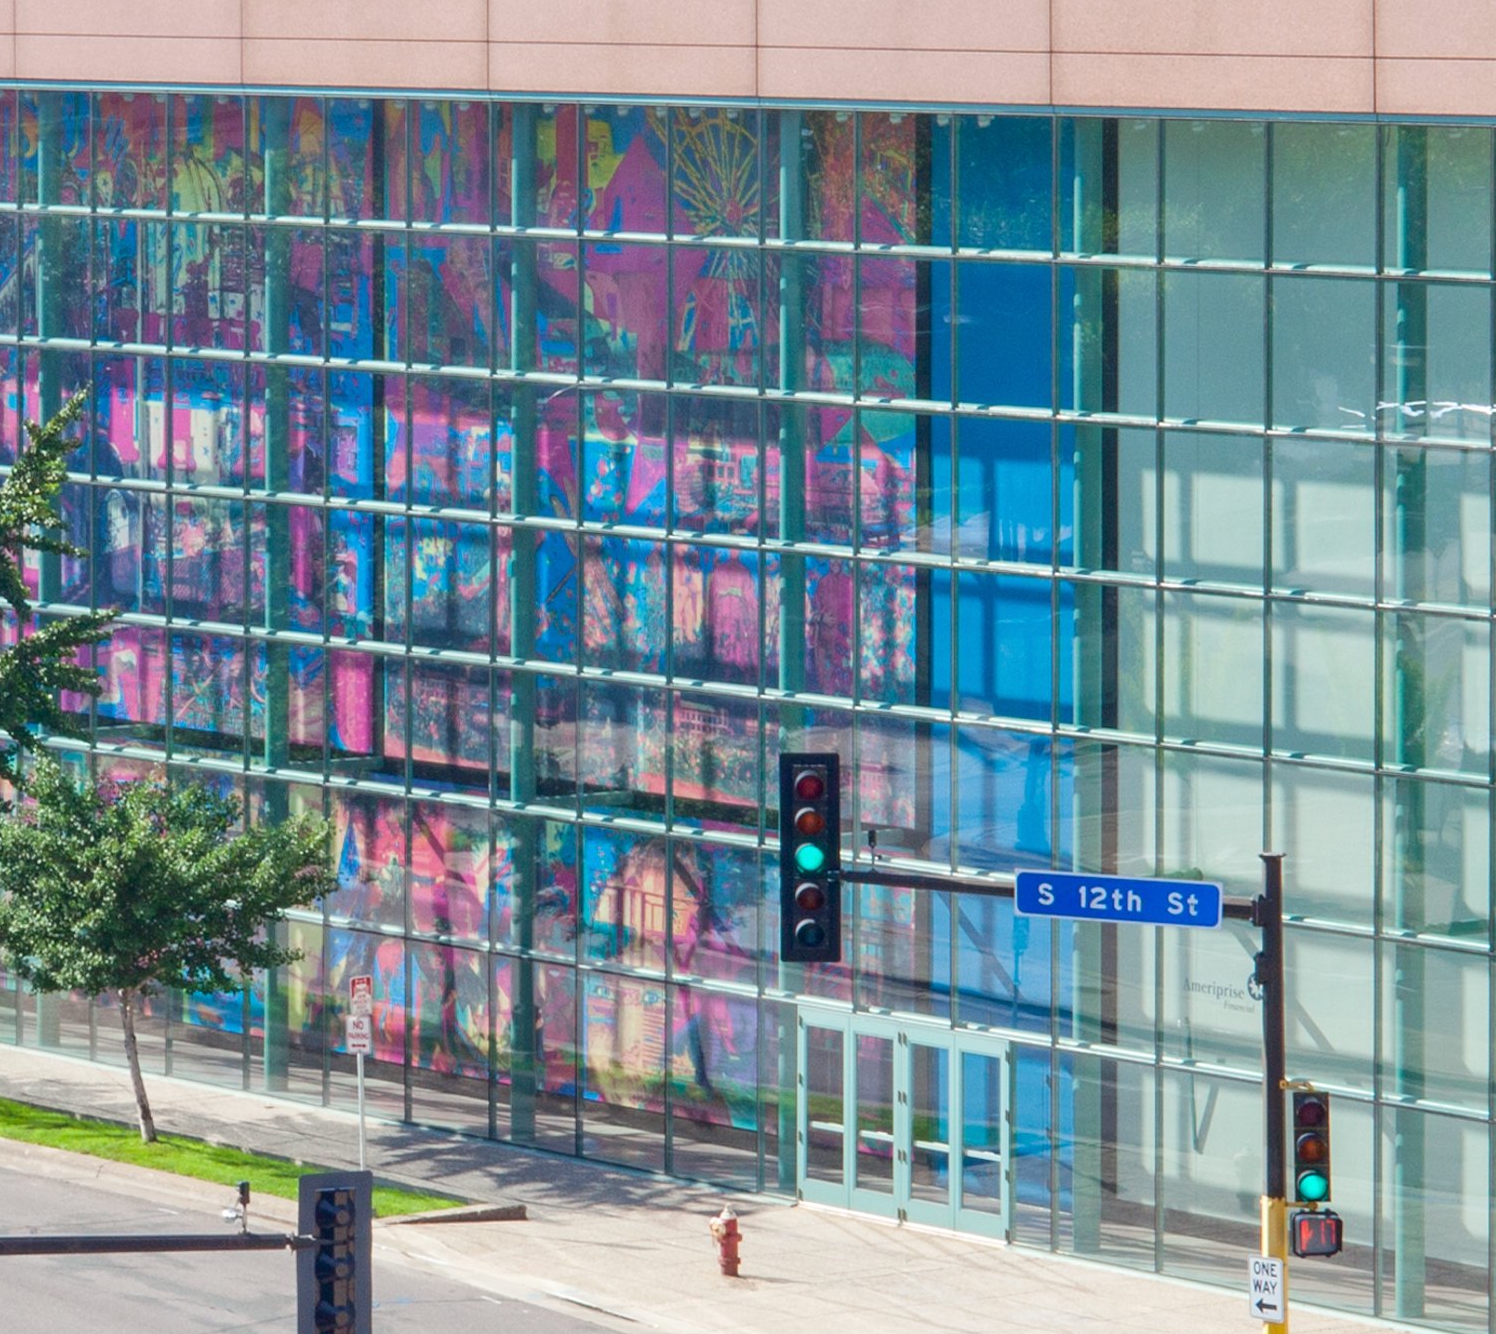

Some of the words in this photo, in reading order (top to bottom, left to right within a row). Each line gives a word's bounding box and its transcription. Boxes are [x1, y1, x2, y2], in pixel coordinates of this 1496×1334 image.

[1038, 882, 1055, 906] S
[1078, 885, 1142, 913] 12th
[1167, 891, 1199, 917] St
[1183, 977, 1245, 1000] Ameriprise
[1223, 999, 1256, 1014] Financial
[353, 1020, 364, 1030] NO
[1253, 1260, 1277, 1278] ONE
[1253, 1278, 1278, 1295] WAY
